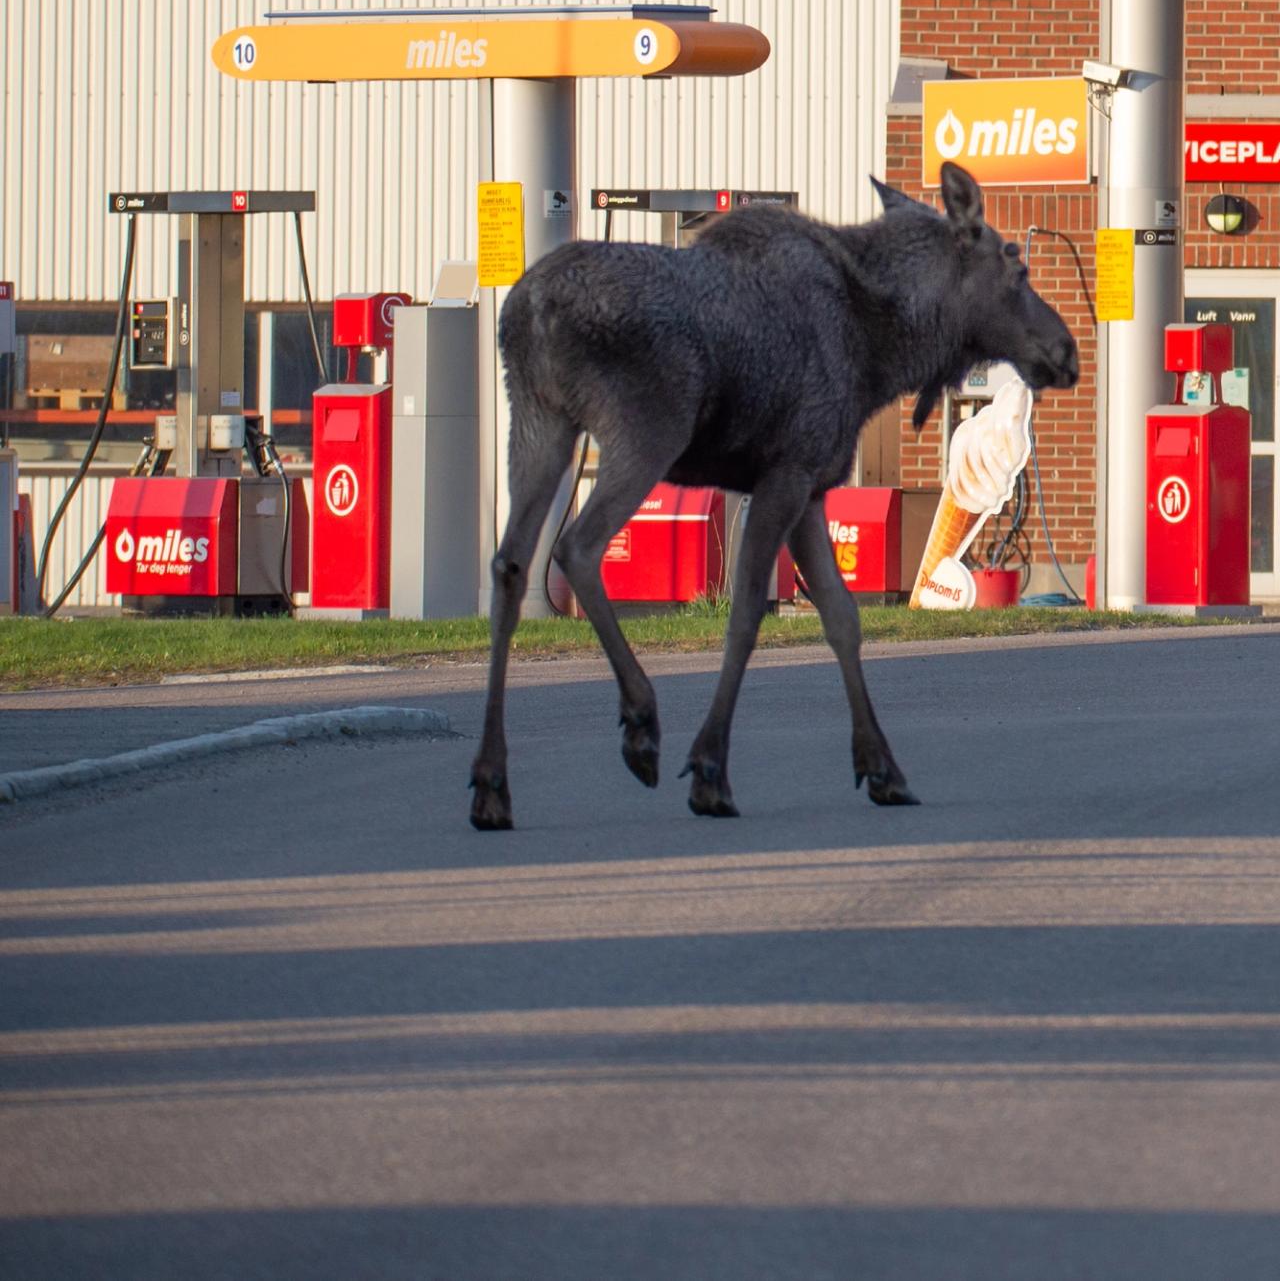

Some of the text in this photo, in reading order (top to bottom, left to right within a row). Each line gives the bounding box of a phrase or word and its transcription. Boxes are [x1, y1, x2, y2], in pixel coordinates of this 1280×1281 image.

[234, 43, 254, 64] 10
[406, 30, 488, 69] miles
[640, 35, 650, 56] 9
[967, 107, 1078, 157] miles
[127, 198, 145, 208] miles
[234, 195, 246, 207] 10
[720, 195, 727, 207] 9
[1197, 310, 1256, 321] Luft Vann
[137, 530, 209, 562] miles
[150, 563, 166, 575] deg
[167, 563, 193, 575] lenger
